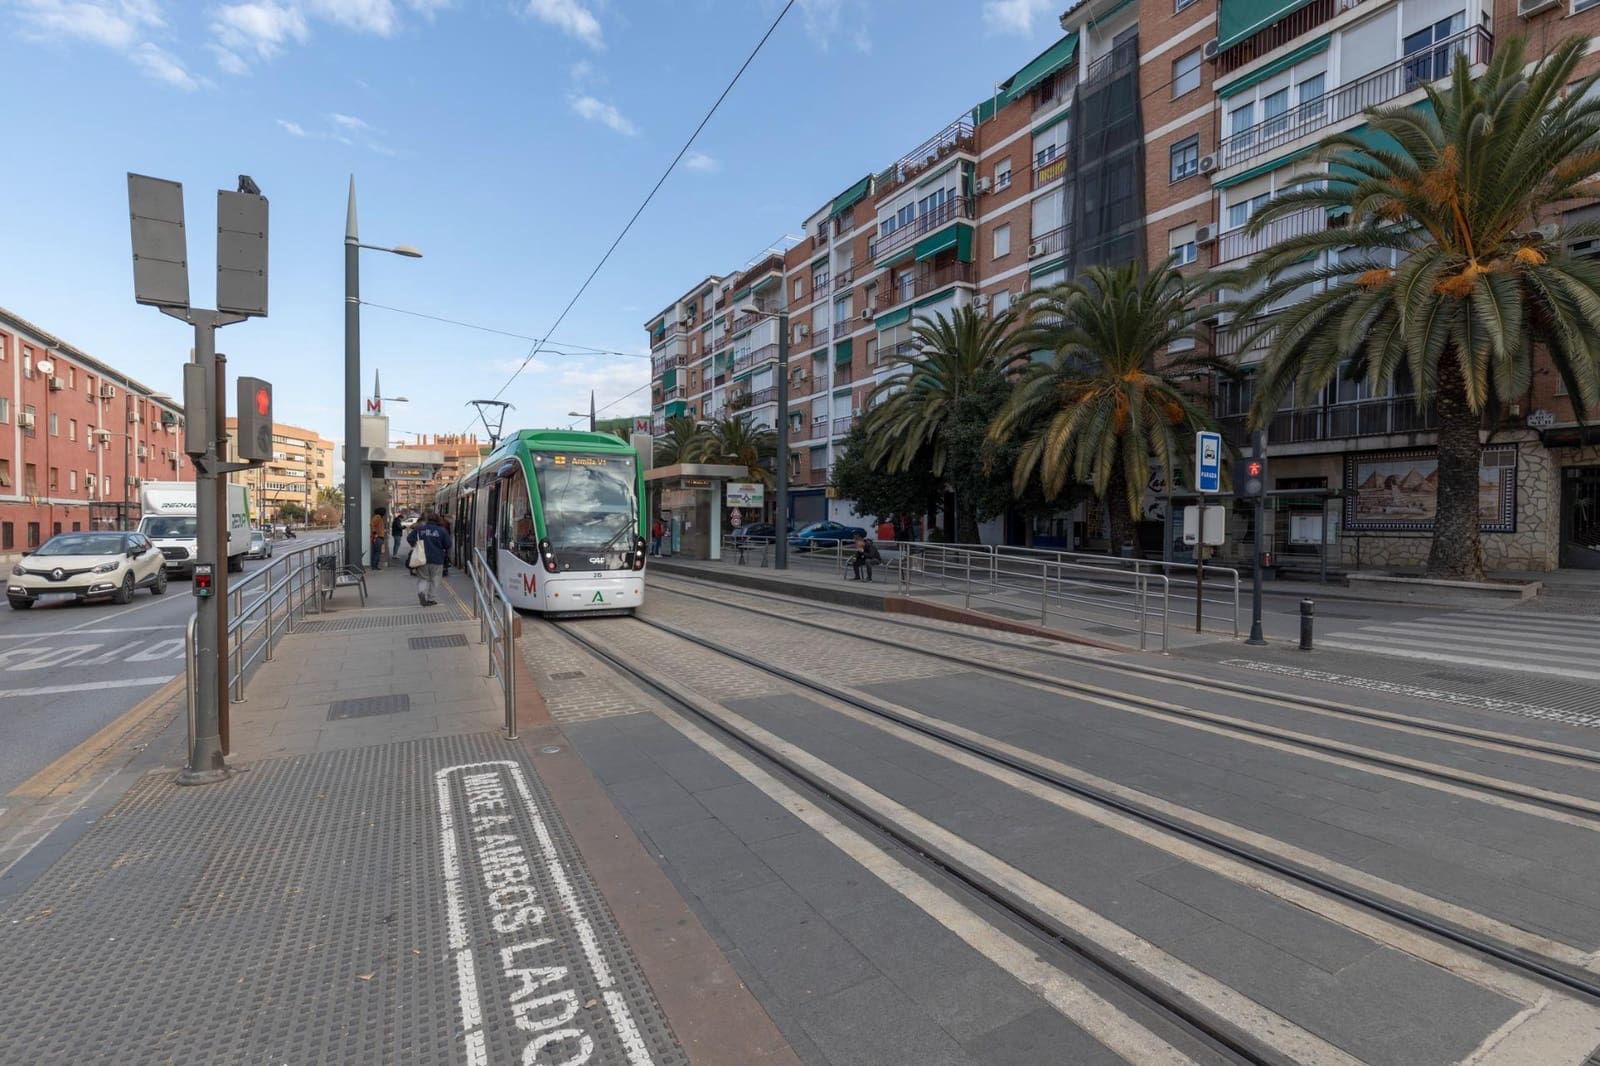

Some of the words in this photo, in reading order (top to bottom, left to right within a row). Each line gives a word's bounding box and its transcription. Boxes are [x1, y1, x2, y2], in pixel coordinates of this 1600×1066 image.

[366, 399, 381, 412] M
[636, 420, 647, 431] M
[523, 573, 536, 597] M
[464, 772, 506, 813] MIRE
[472, 815, 512, 833] A
[477, 835, 546, 933] AMBOS
